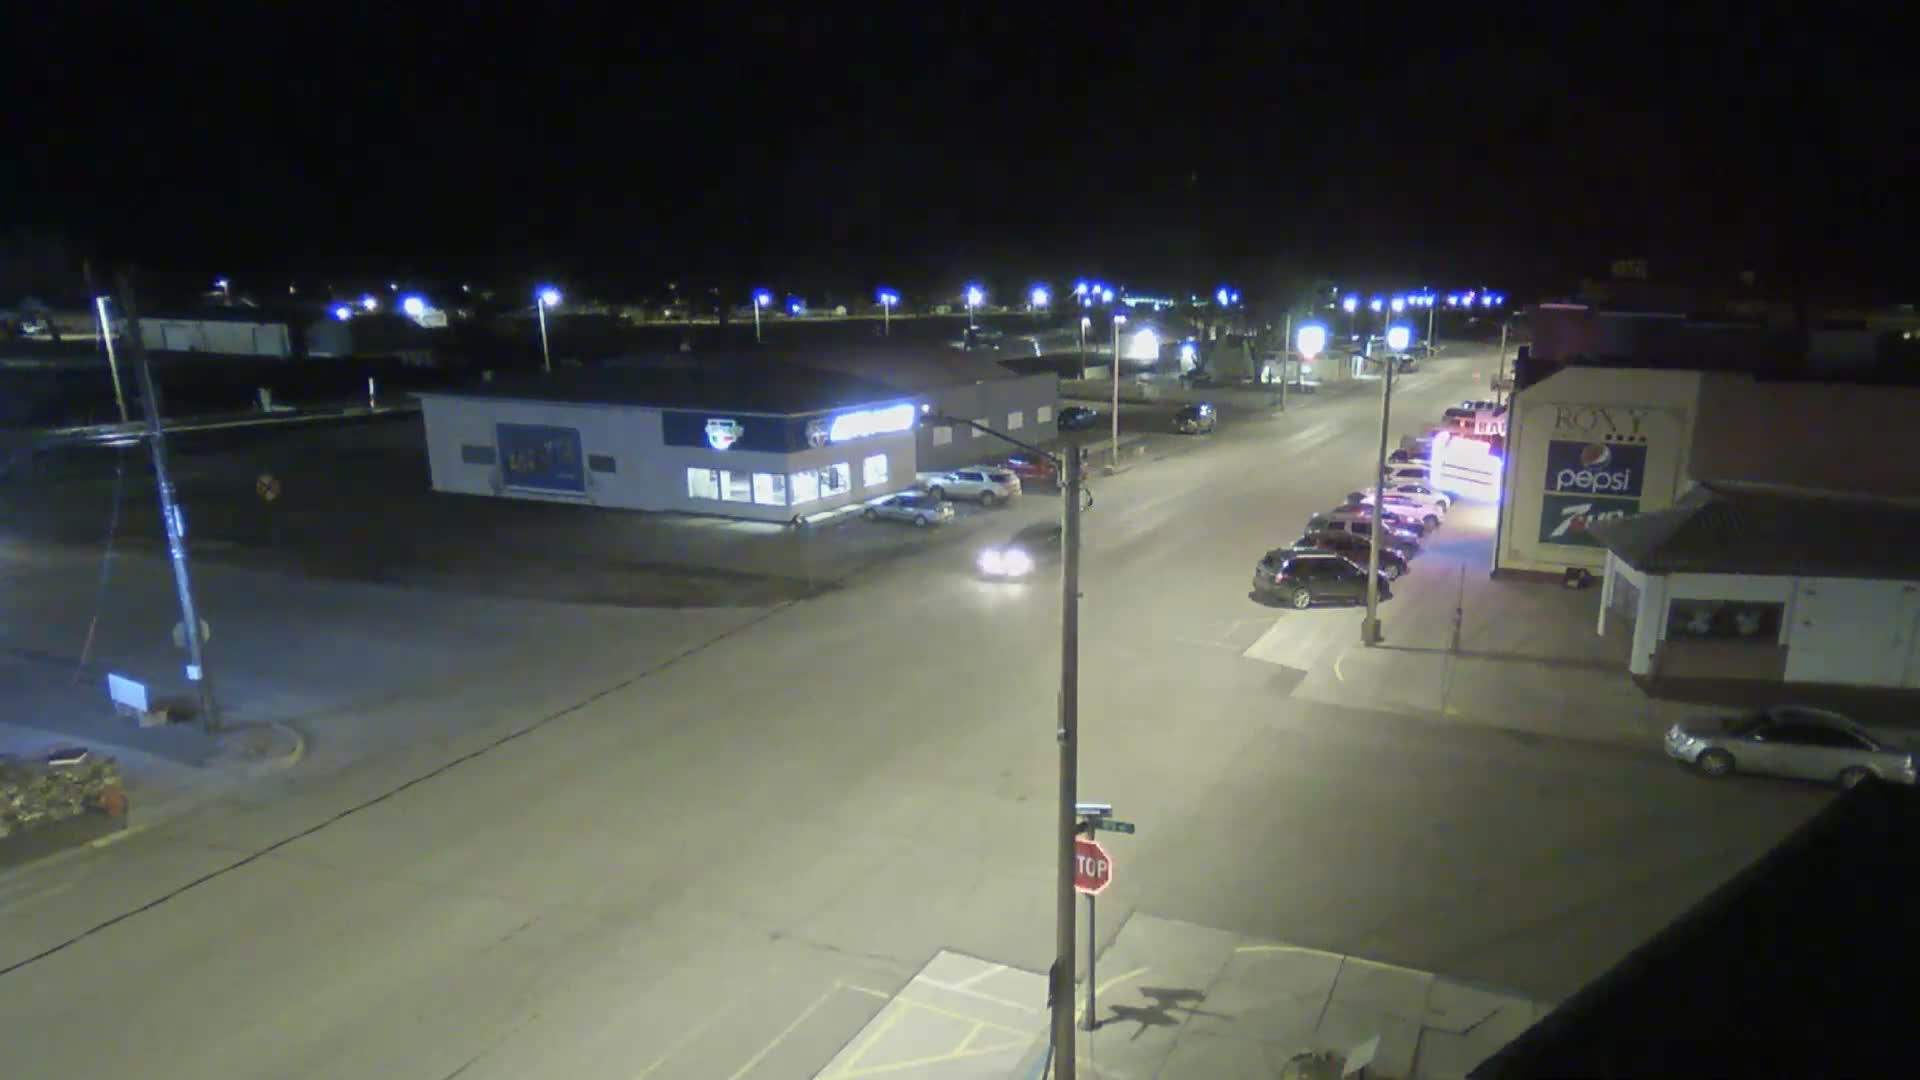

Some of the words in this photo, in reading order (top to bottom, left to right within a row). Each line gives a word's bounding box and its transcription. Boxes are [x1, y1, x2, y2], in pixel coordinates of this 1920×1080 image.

[1554, 406, 1648, 433] ROXY
[1556, 468, 1631, 493] pepsi
[1076, 855, 1107, 878] TOP
